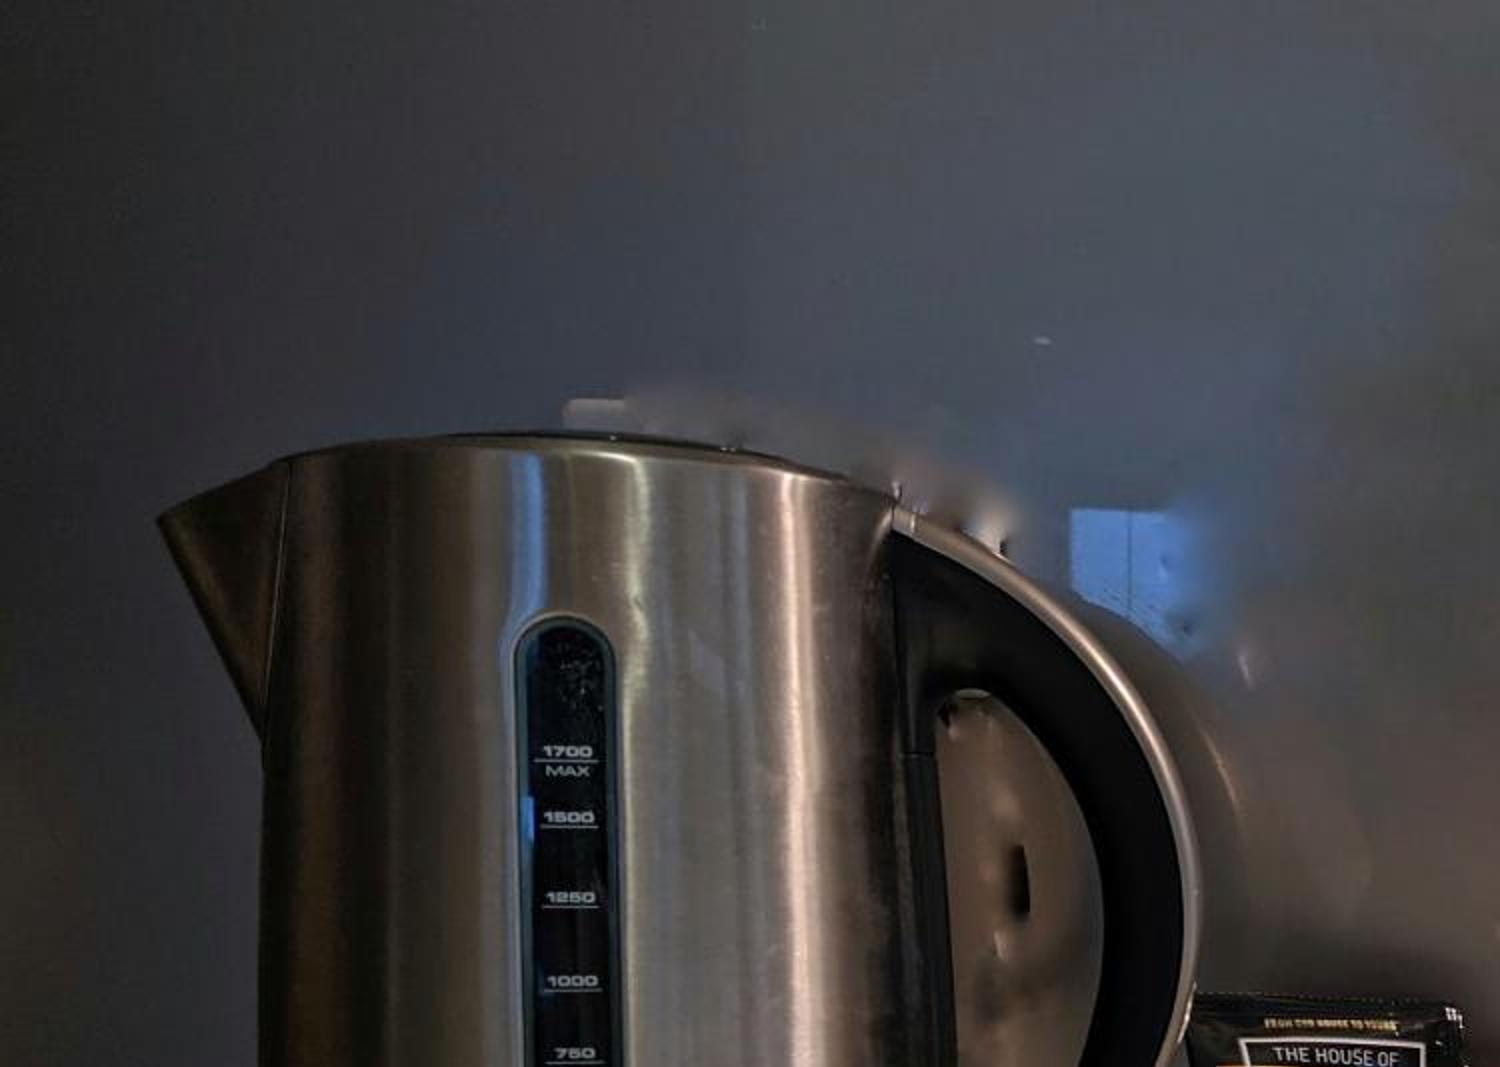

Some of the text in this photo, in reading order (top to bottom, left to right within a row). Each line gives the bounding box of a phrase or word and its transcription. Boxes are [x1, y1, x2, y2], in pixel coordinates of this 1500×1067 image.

[543, 744, 593, 758] 1700
[545, 764, 590, 777] MAX
[543, 810, 595, 823] 1500
[546, 891, 596, 903] 1250
[547, 975, 599, 987] 1000
[553, 1047, 596, 1059] 750
[1272, 1046, 1401, 1067] THE HOUSE OF
